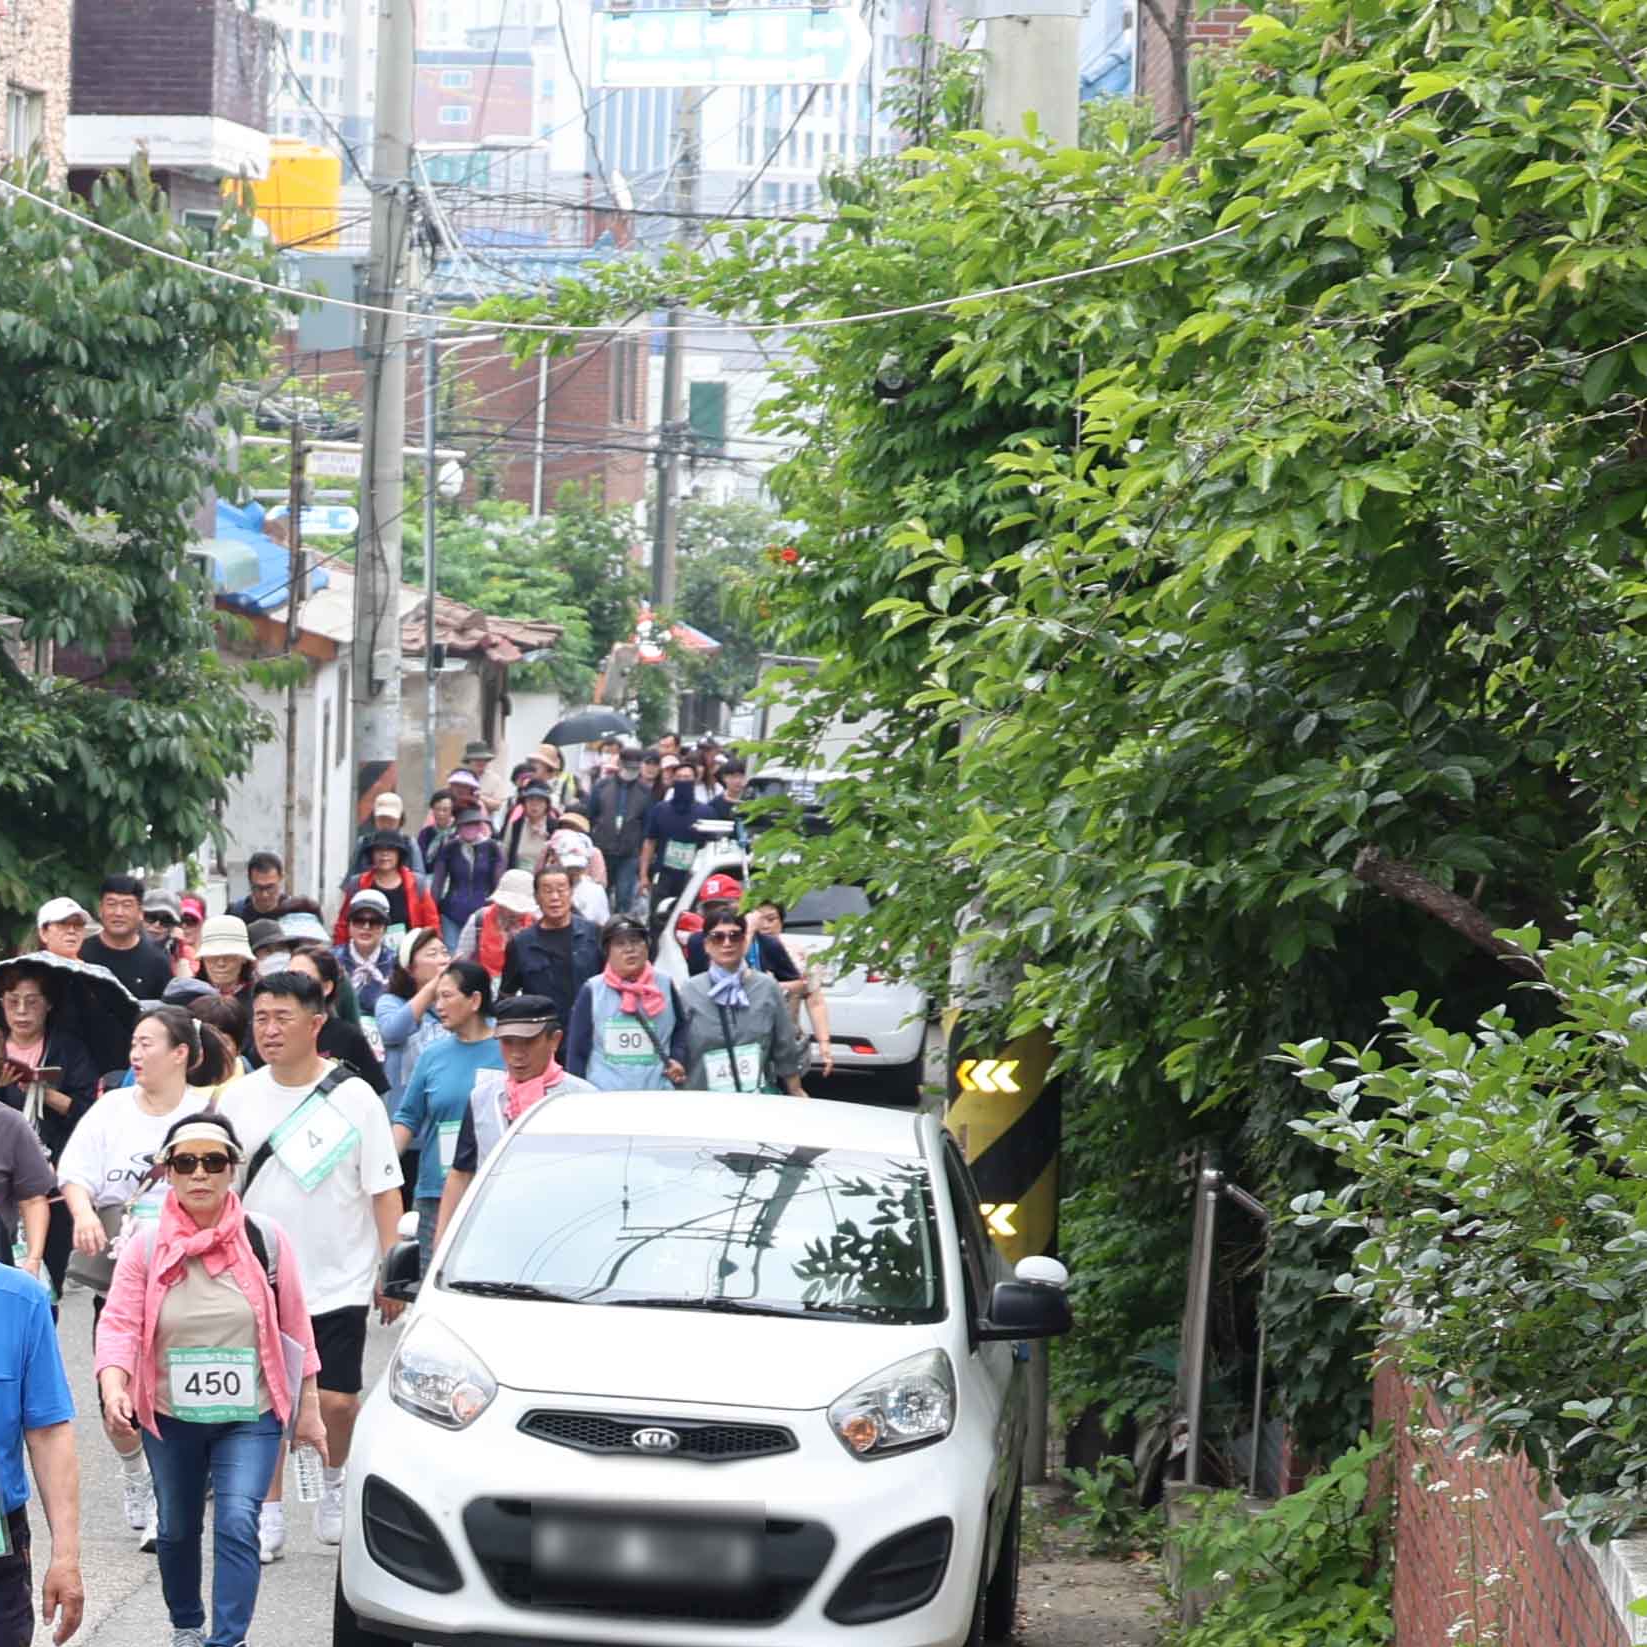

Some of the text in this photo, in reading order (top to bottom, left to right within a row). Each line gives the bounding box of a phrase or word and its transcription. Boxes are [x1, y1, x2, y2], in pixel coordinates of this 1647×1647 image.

[619, 1033, 642, 1048] 90
[716, 1059, 751, 1079] 48
[307, 1129, 323, 1149] 4
[184, 1371, 241, 1396] 450
[639, 1431, 673, 1450] KIA
